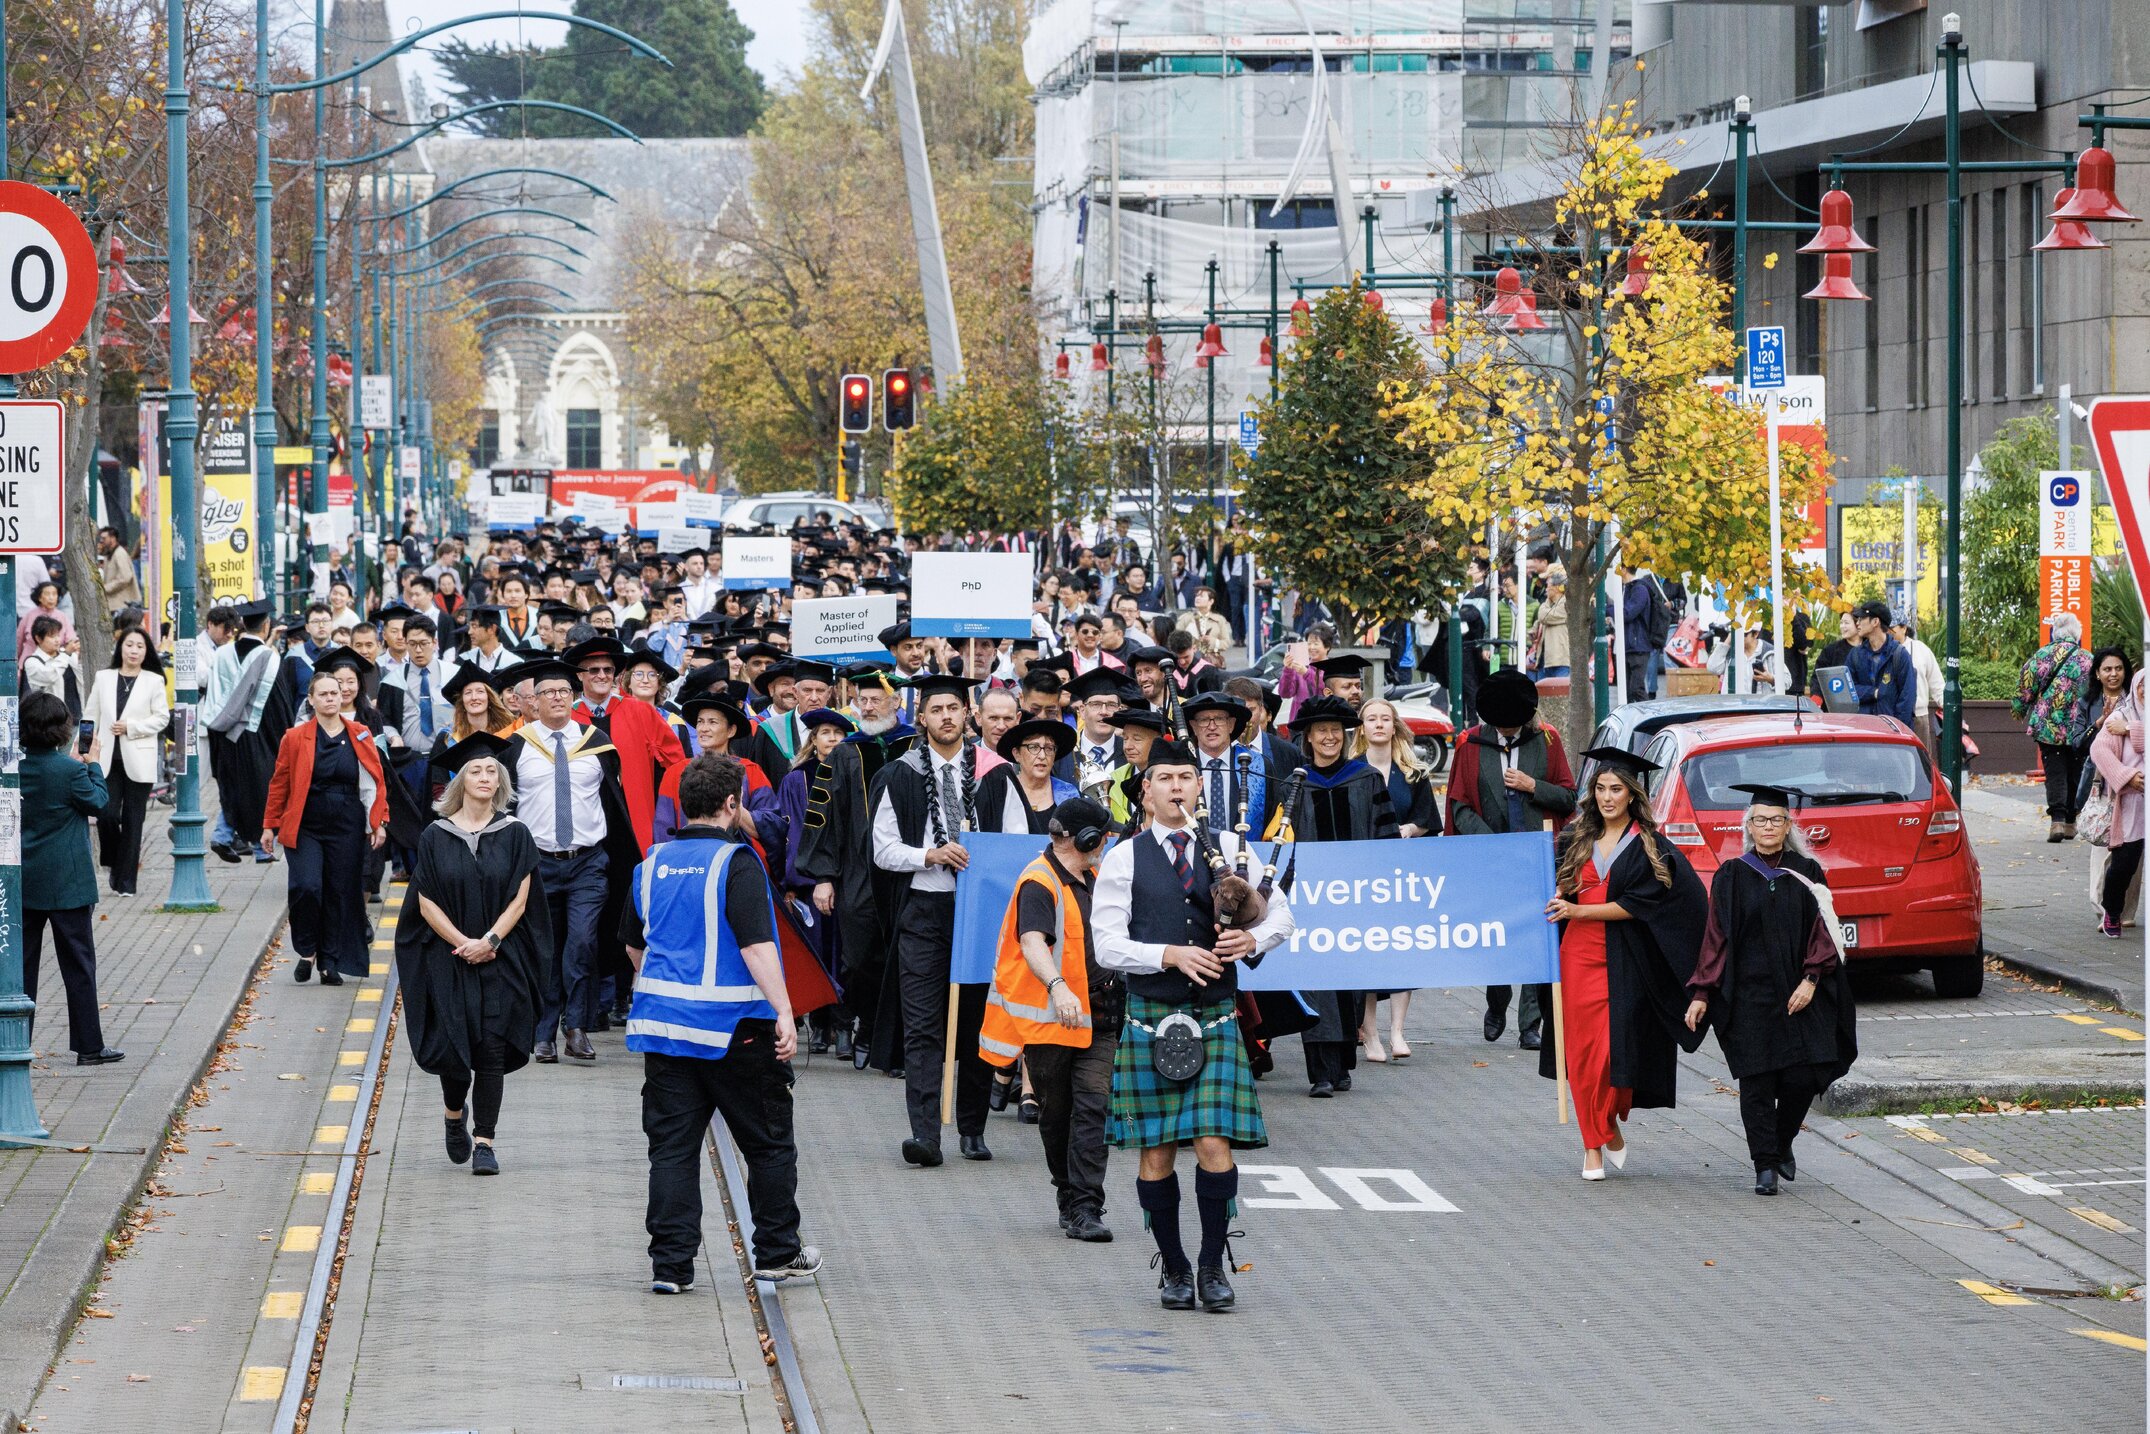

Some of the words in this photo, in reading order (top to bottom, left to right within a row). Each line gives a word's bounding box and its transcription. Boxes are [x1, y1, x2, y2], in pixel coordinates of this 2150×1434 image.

[1758, 350, 1775, 364] 120
[1748, 393, 1813, 410] Wlson
[2053, 484, 2077, 499] CP
[2054, 511, 2065, 550] PARK
[220, 558, 245, 572] shot
[740, 554, 774, 562] Masters
[961, 581, 982, 590] PhD
[2068, 560, 2081, 610] PUBLIC
[819, 611, 853, 621] Master
[858, 609, 869, 619] of
[823, 621, 865, 634] Applied
[814, 633, 874, 645] Computing
[176, 664, 196, 672] NOW
[1832, 680, 1842, 692] P
[1289, 868, 1446, 909] iversity
[1289, 914, 1507, 953] rocession
[1236, 1165, 1464, 1213] 30
